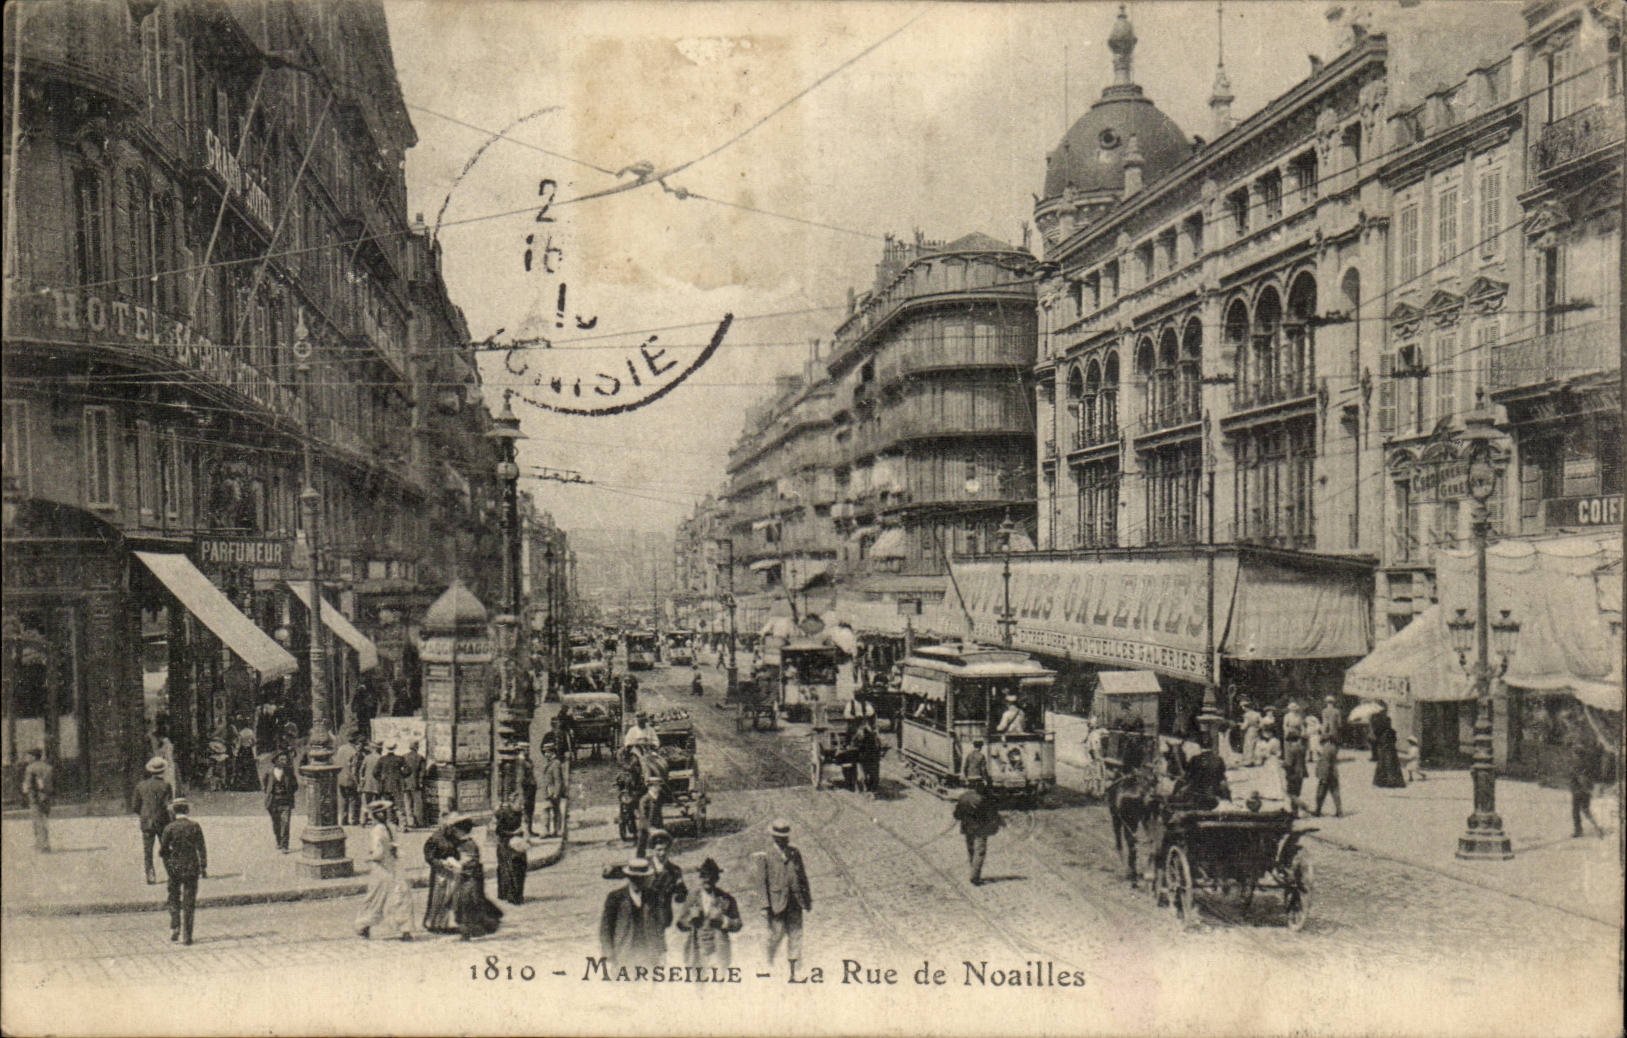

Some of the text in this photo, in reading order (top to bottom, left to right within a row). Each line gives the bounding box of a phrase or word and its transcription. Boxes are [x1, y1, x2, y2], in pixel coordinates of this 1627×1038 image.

[53, 290, 161, 346] HOTEL
[200, 541, 283, 564] PARFUMEUR
[1076, 636, 1136, 661] NOUVELLES
[1138, 644, 1197, 673] GALERIES
